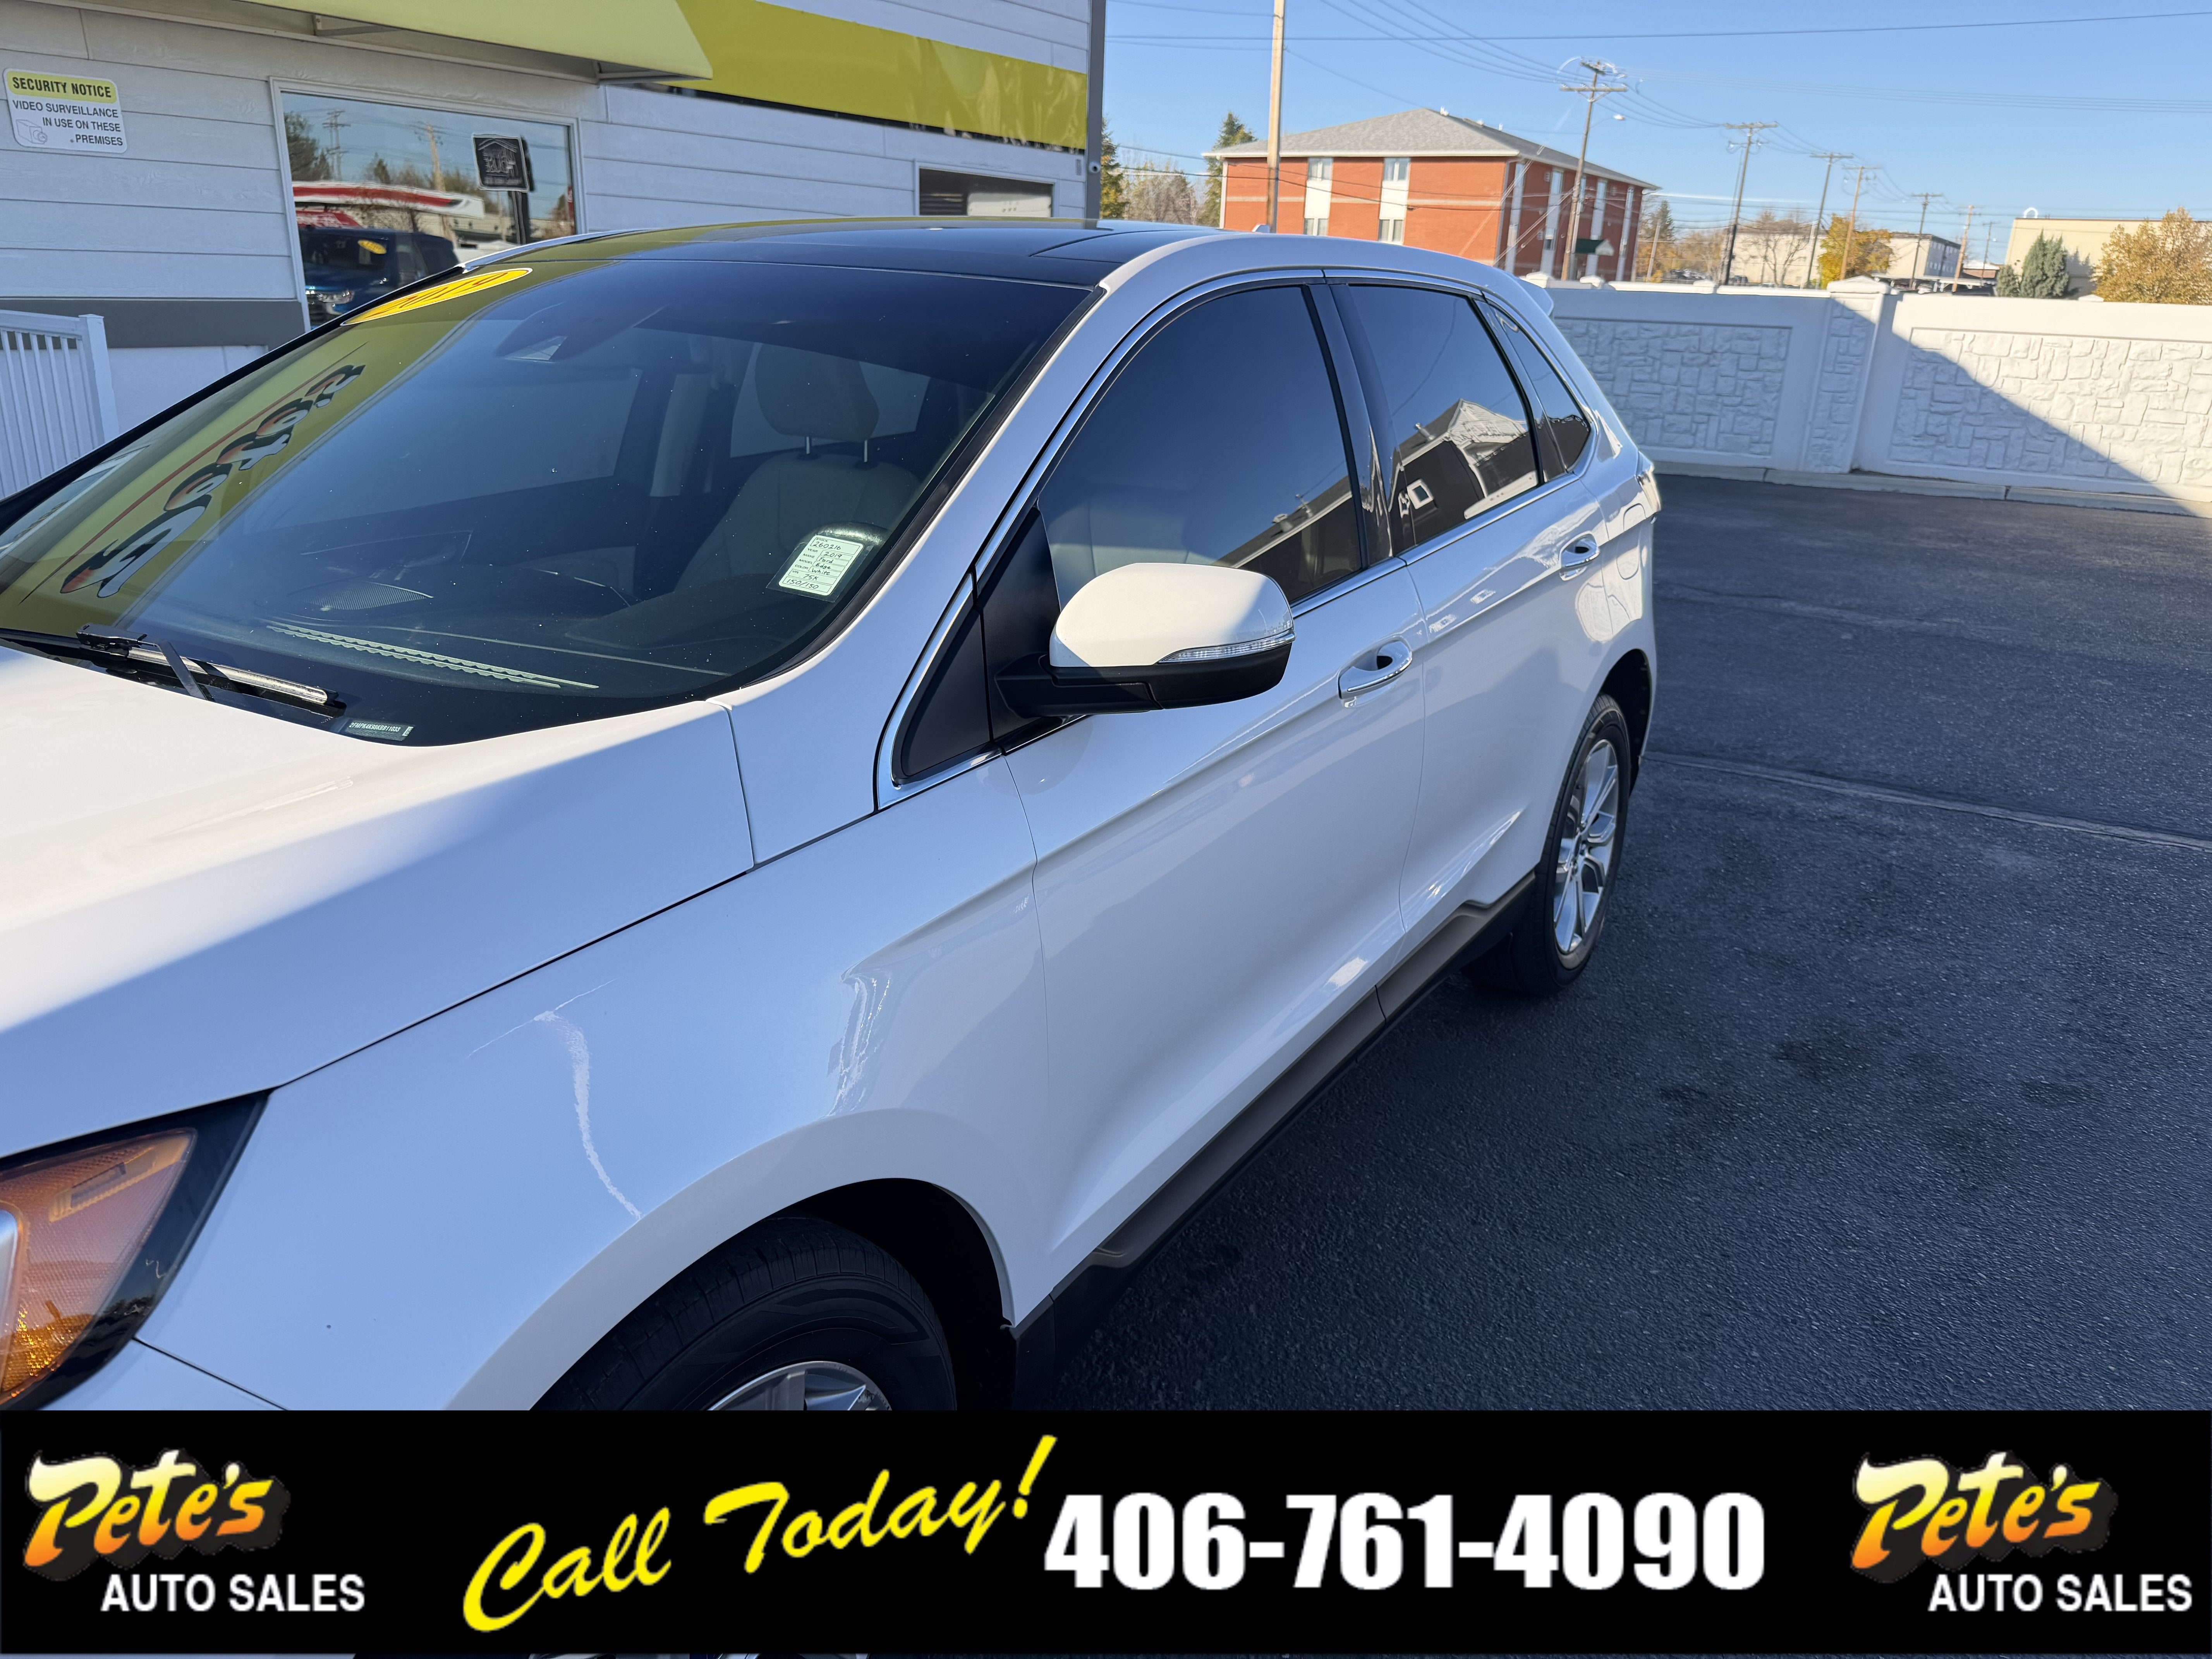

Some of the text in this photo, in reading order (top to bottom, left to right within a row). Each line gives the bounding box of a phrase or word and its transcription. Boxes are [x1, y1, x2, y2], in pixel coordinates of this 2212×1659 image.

[12, 77, 112, 98] SECURITY NOTICE
[12, 100, 118, 118] VIDEO SURVEILLANCE
[42, 117, 121, 132] IN USE ON THESE
[75, 134, 123, 146] PREMISES
[813, 541, 841, 550] 260216
[787, 579, 819, 589] 150/150
